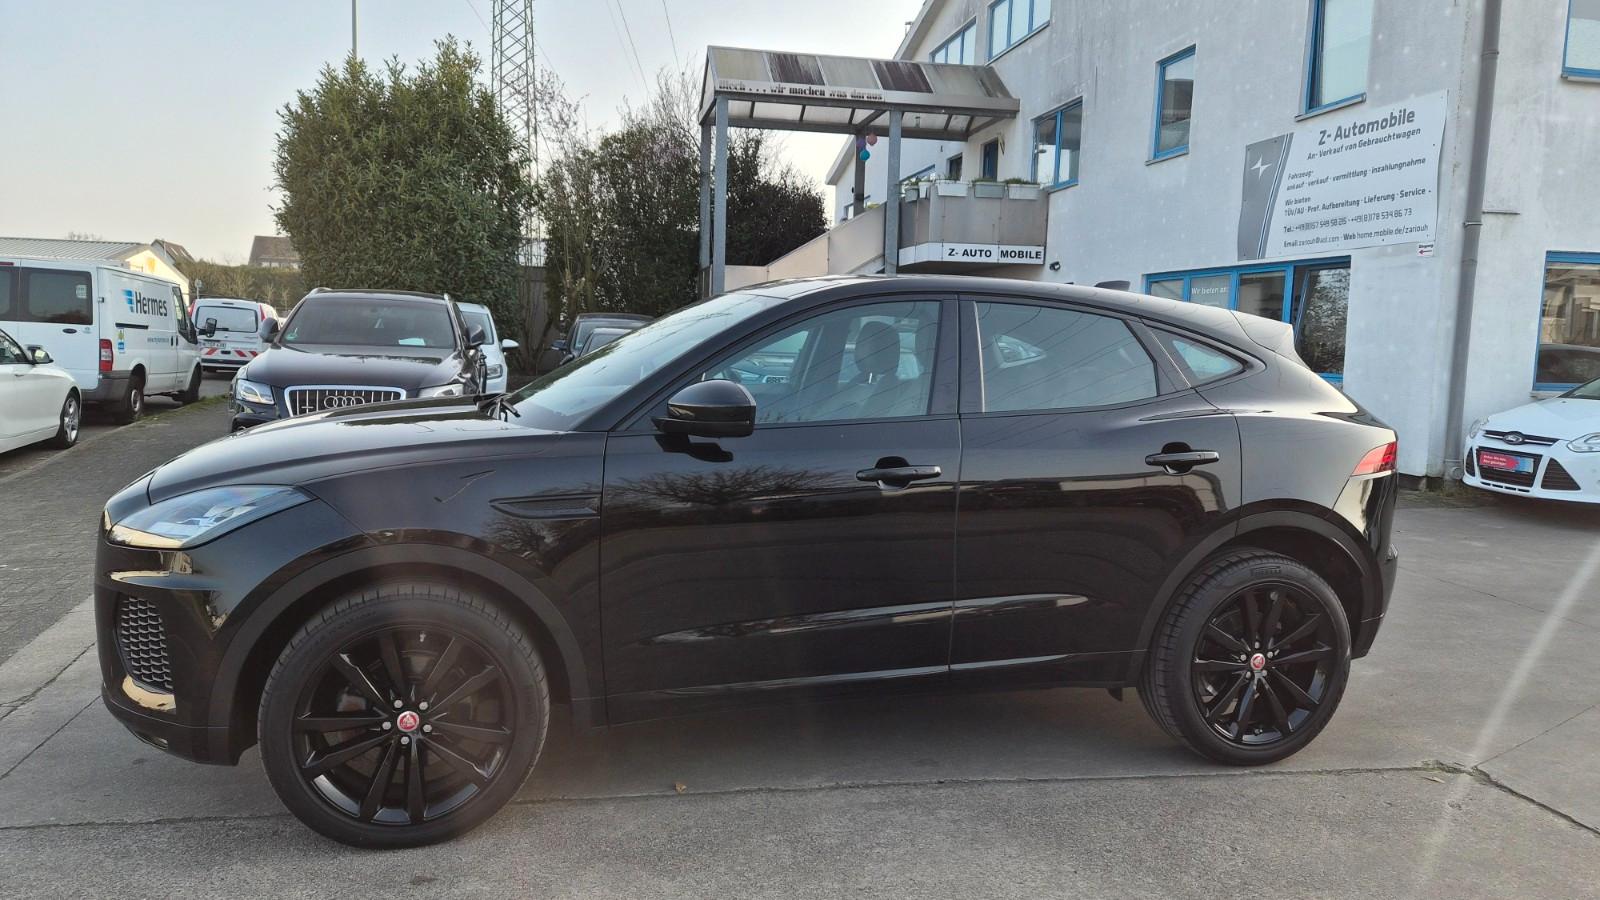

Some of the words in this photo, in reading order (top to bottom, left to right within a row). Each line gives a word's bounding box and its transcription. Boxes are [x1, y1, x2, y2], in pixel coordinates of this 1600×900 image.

[789, 86, 826, 97] machen
[1333, 108, 1416, 142] Automobile
[1319, 145, 1344, 158] Verkauf
[1344, 142, 1357, 151] von
[1358, 128, 1422, 148] Gebrauchtwagen
[1307, 176, 1330, 187] verkauf
[1332, 168, 1368, 182] vermittlung
[1371, 157, 1427, 175] inzahlungnahme
[1321, 198, 1360, 211] Aufbereitung
[1363, 192, 1396, 205] Lieferung
[1399, 187, 1426, 199] Service
[1404, 207, 1413, 216] 73
[962, 248, 992, 258] AUTO
[1000, 250, 1042, 259] MOBILE
[134, 291, 168, 317] Hermes
